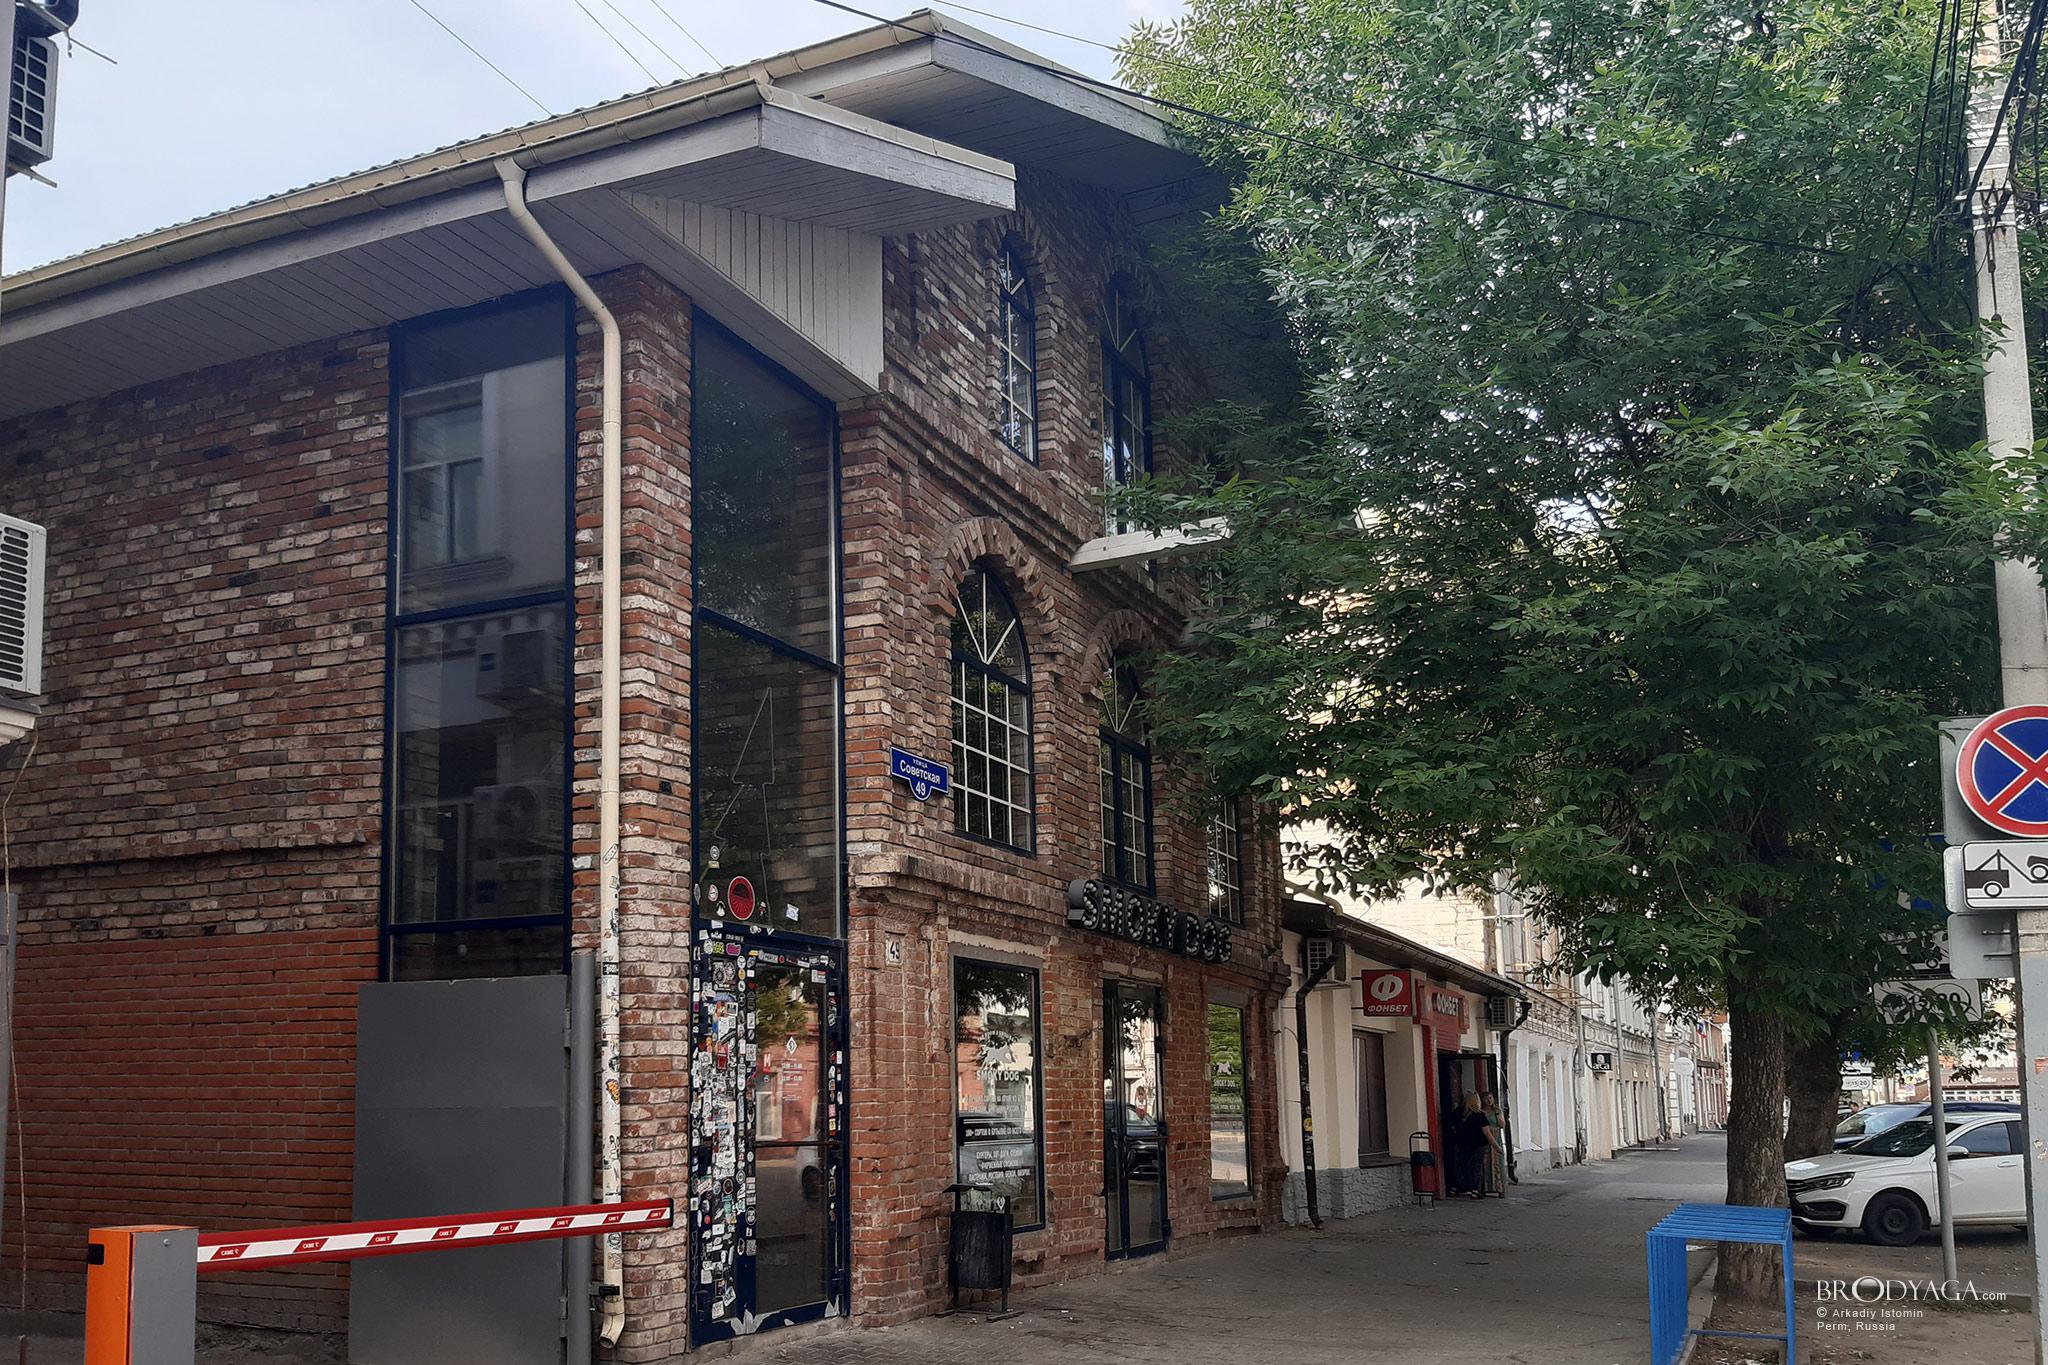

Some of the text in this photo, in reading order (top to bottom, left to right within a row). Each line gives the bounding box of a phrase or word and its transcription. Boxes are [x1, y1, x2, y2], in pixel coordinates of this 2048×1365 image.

[899, 759, 941, 785] Советская
[915, 780, 926, 796] 49
[1074, 879, 1233, 964] SMOKY DOG
[890, 940, 900, 960] 49
[1367, 1004, 1409, 1013] ФОНБЕТ
[1436, 992, 1459, 1017] ФОНБЕТ
[976, 1069, 1020, 1081] SMOKY DOG
